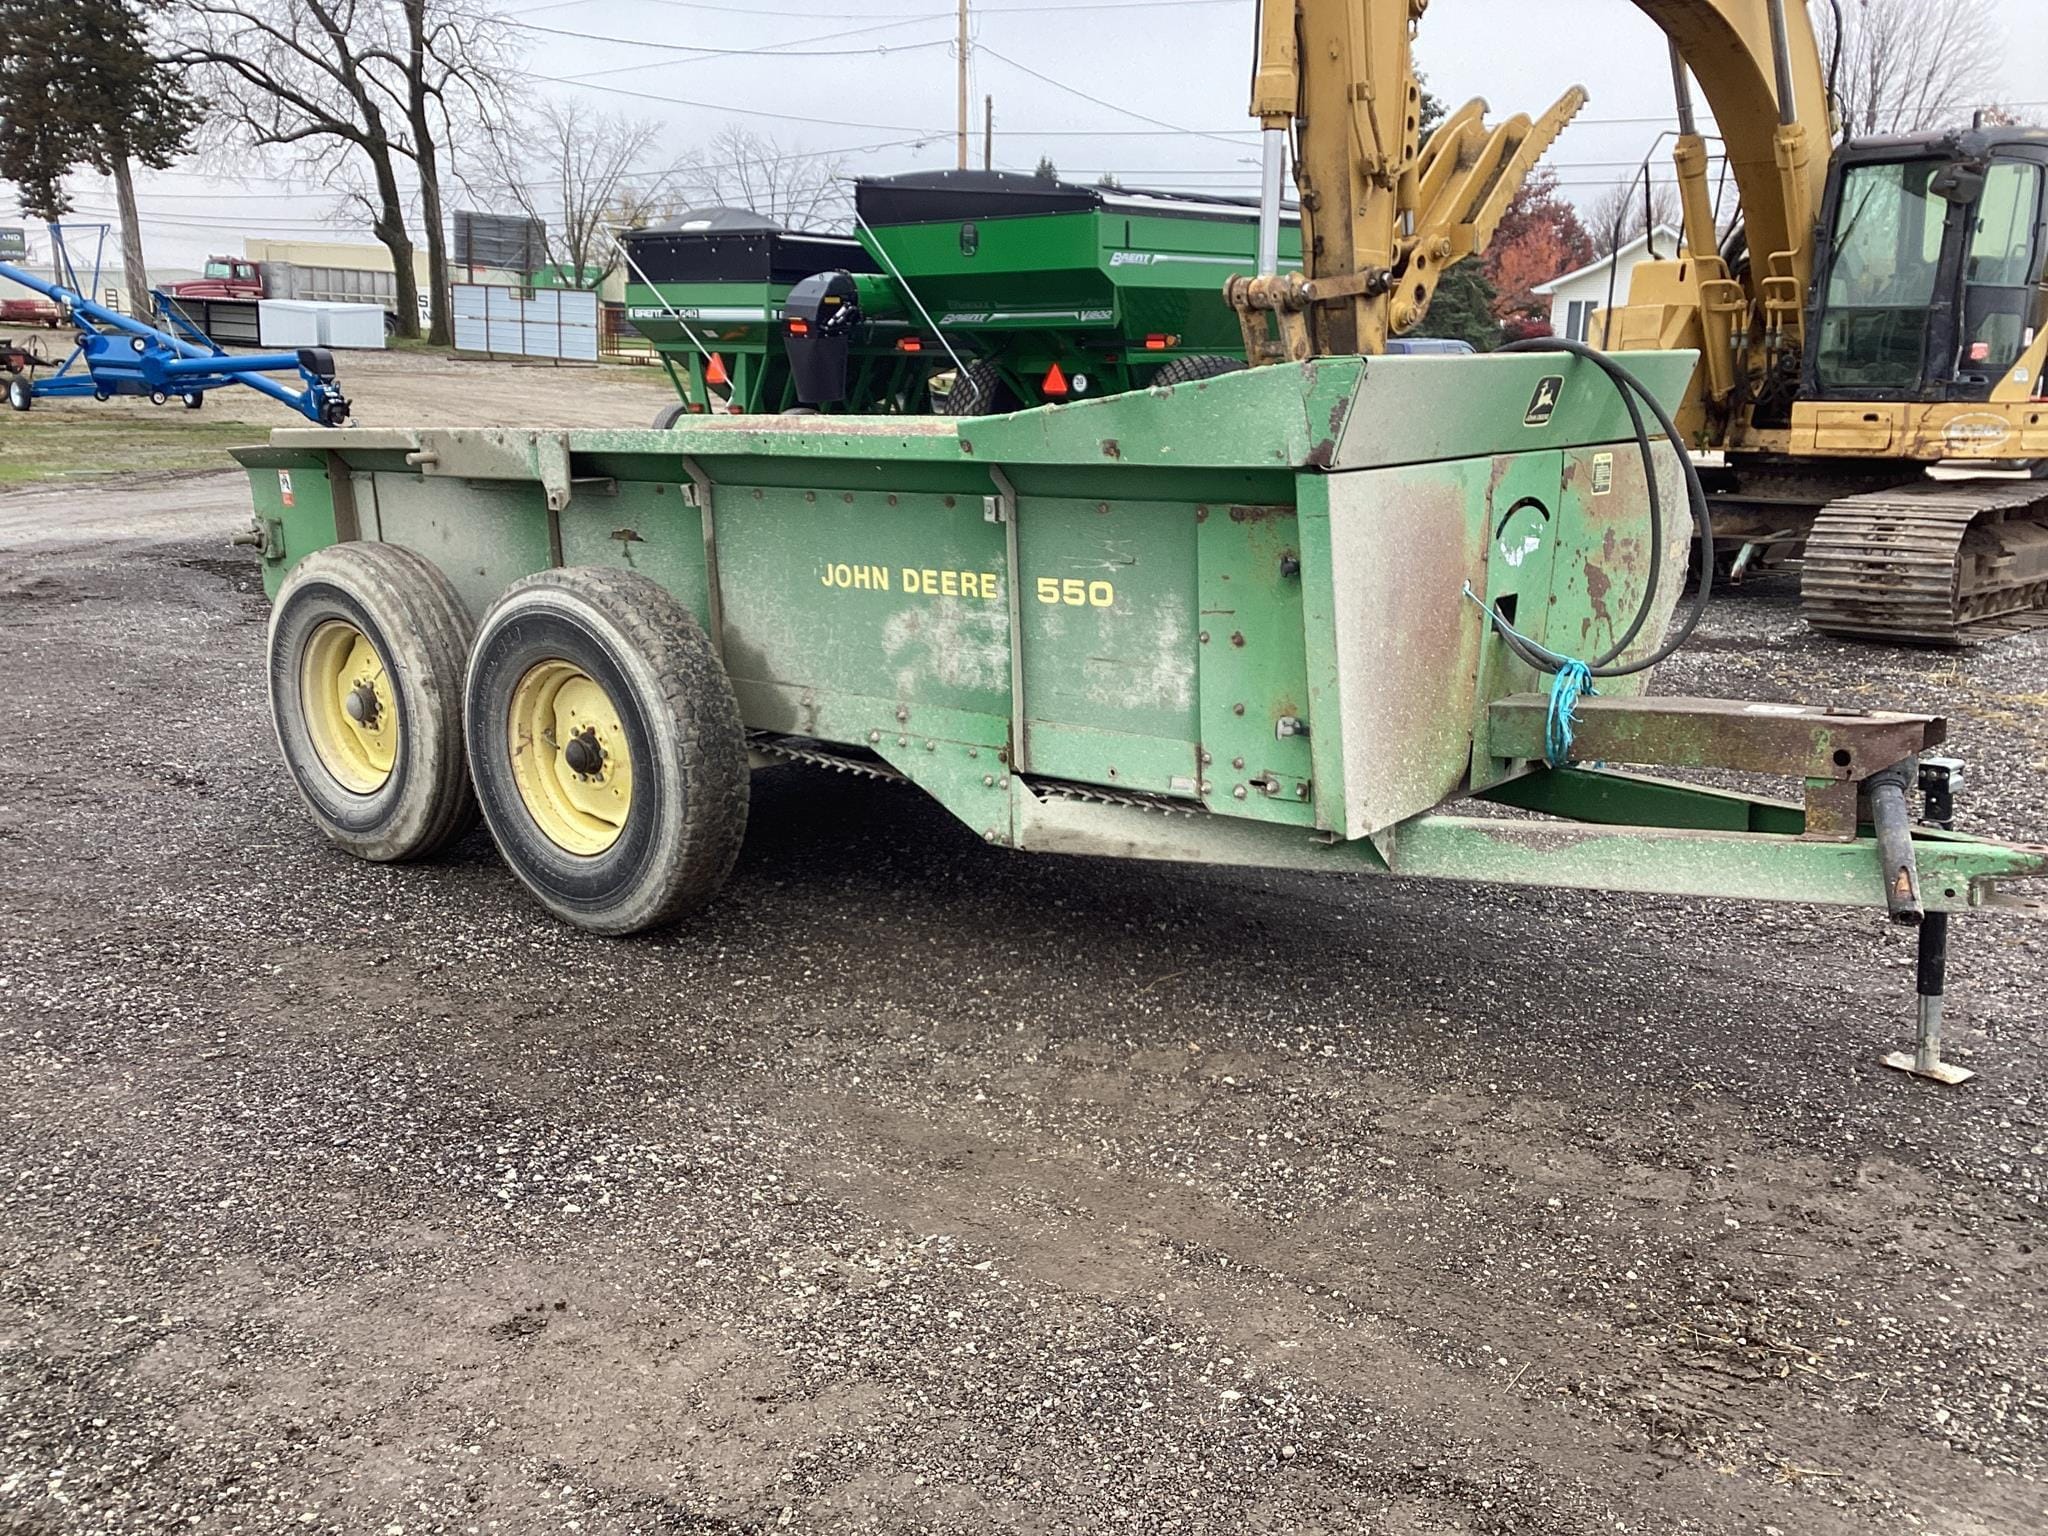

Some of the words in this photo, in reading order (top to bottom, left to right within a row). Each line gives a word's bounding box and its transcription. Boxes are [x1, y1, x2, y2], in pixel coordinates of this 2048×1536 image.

[1109, 251, 1151, 266] BRENT
[634, 309, 663, 318] BRENT
[821, 563, 889, 591] JOHN
[902, 567, 998, 599] DEERE
[1037, 577, 1114, 607] 550
